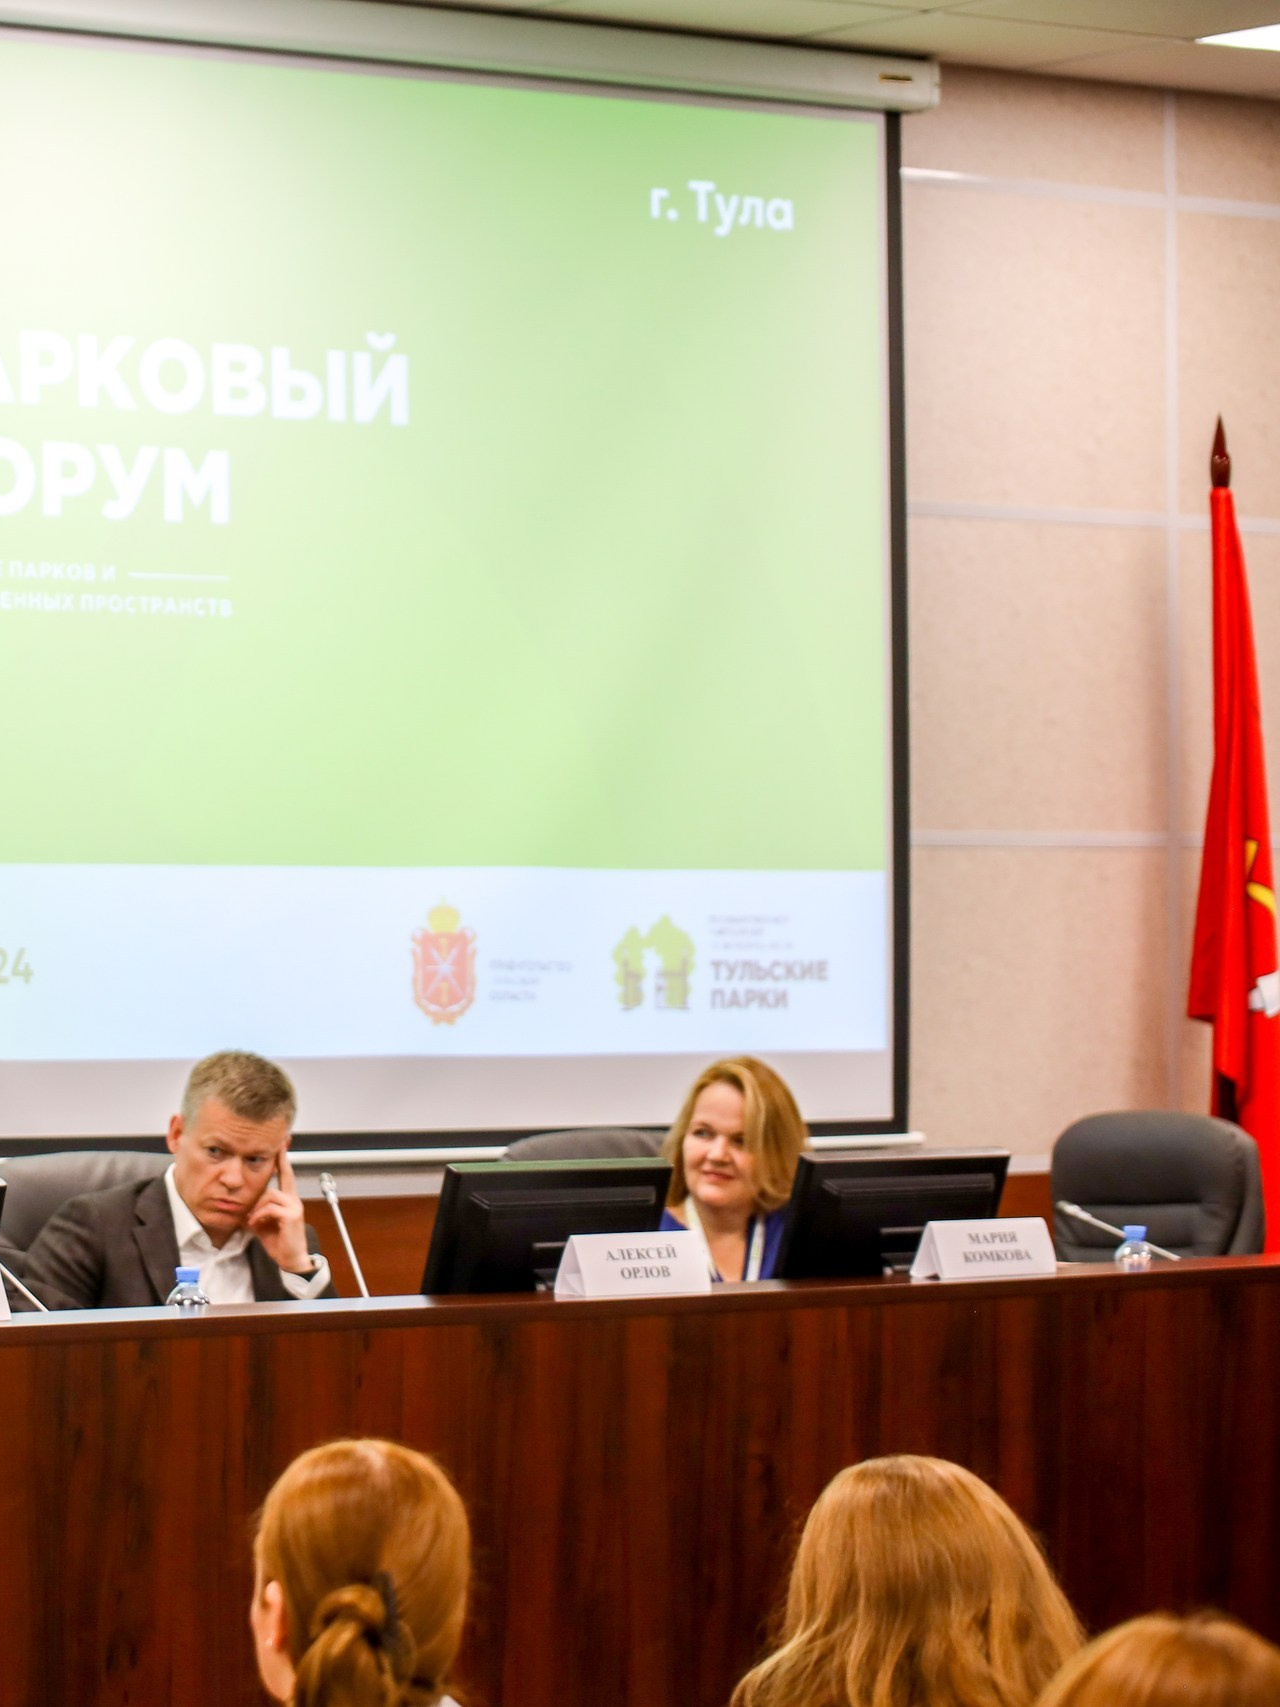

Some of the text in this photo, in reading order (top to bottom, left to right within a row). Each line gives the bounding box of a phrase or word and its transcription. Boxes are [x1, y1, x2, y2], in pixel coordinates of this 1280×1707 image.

[650, 179, 794, 237] г. Тула
[8, 560, 97, 583] ПАРКОВ
[101, 564, 117, 583] И
[80, 593, 233, 618] ПРОСТРАНСТВ
[709, 959, 830, 982] ТУЛЬСКИЕ
[710, 987, 789, 1010] ПАРКИ
[968, 1231, 1018, 1245] МАРИЯ
[605, 1244, 678, 1262] АЛЕКСЕЙ
[962, 1248, 1033, 1263] КОМКОВА
[620, 1266, 671, 1280] ОРЛОВ
